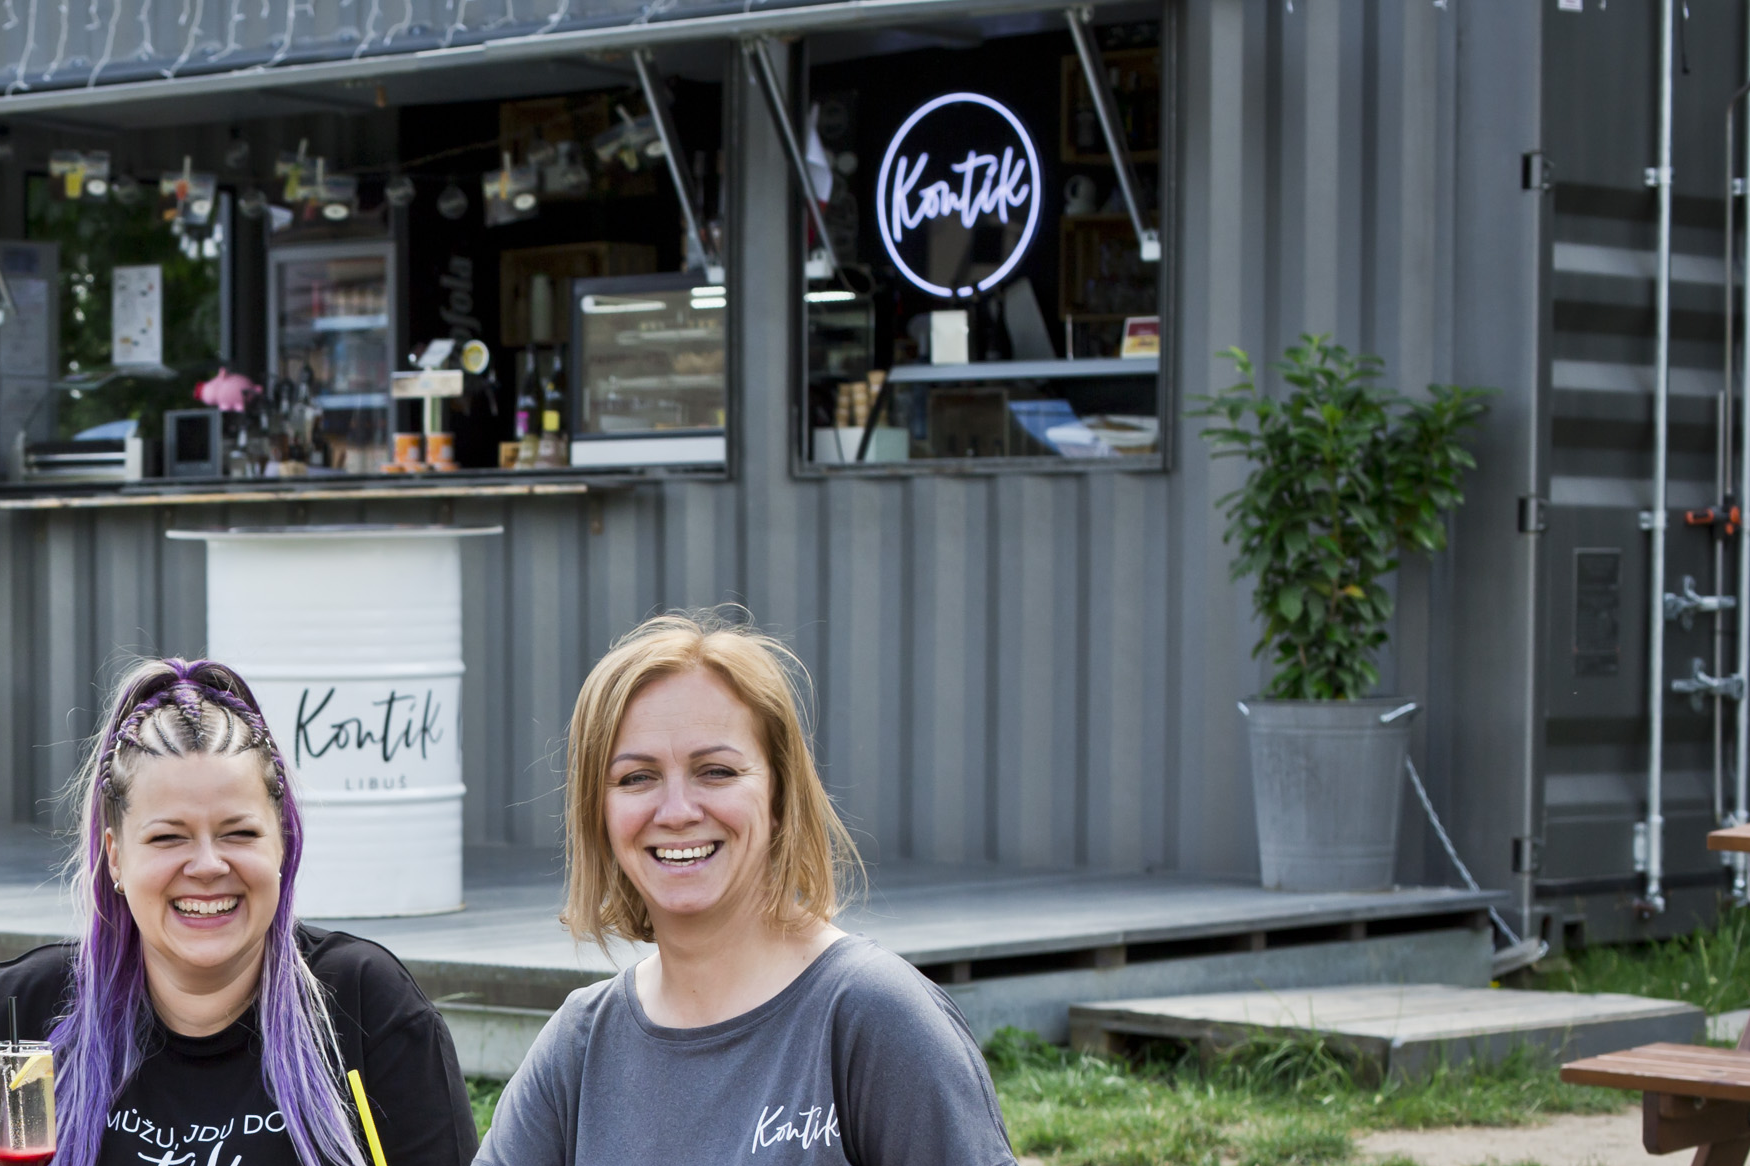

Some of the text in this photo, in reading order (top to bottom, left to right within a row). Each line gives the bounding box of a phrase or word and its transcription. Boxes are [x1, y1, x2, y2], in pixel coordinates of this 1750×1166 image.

[892, 146, 1030, 243] Kontik
[296, 686, 443, 769] Kontik
[106, 1108, 287, 1150] MŮŽU, JDU DO
[752, 1102, 840, 1153] Kontik
